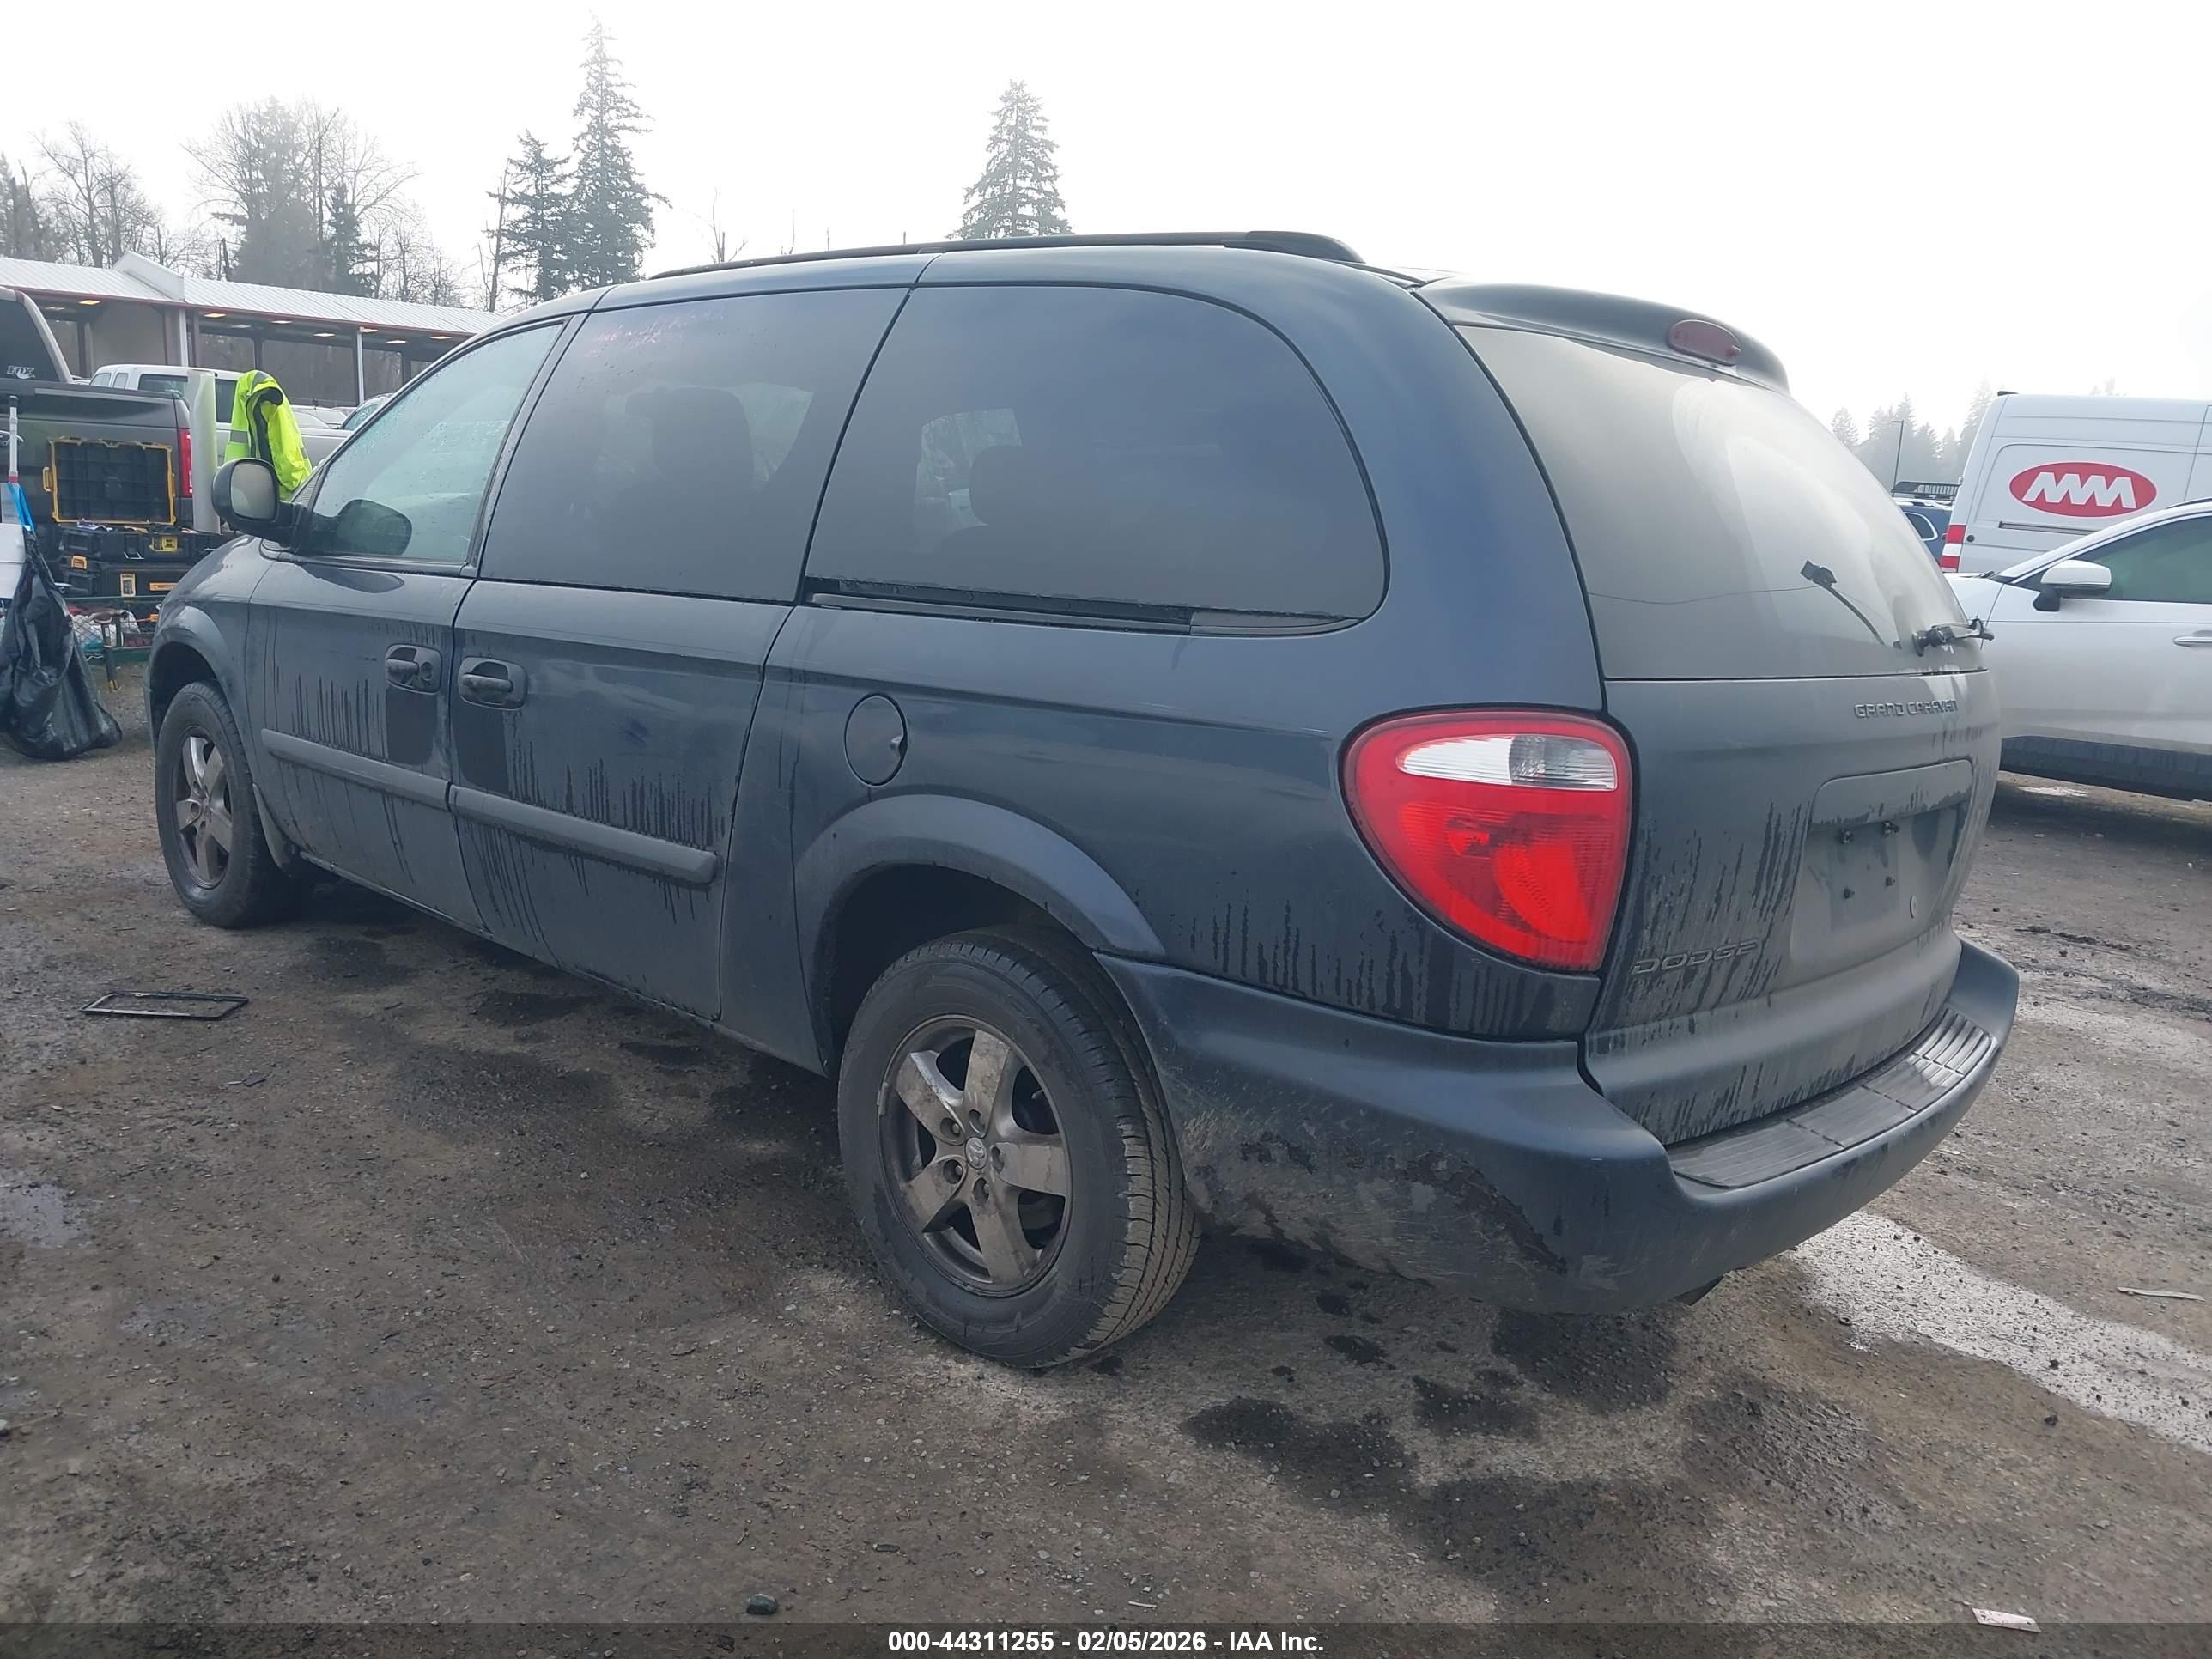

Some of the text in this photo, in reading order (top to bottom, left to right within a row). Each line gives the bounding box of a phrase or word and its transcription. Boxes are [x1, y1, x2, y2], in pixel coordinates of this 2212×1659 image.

[1854, 699, 1958, 718] GRAND CARAVAN
[1632, 939, 1759, 975] DODGE
